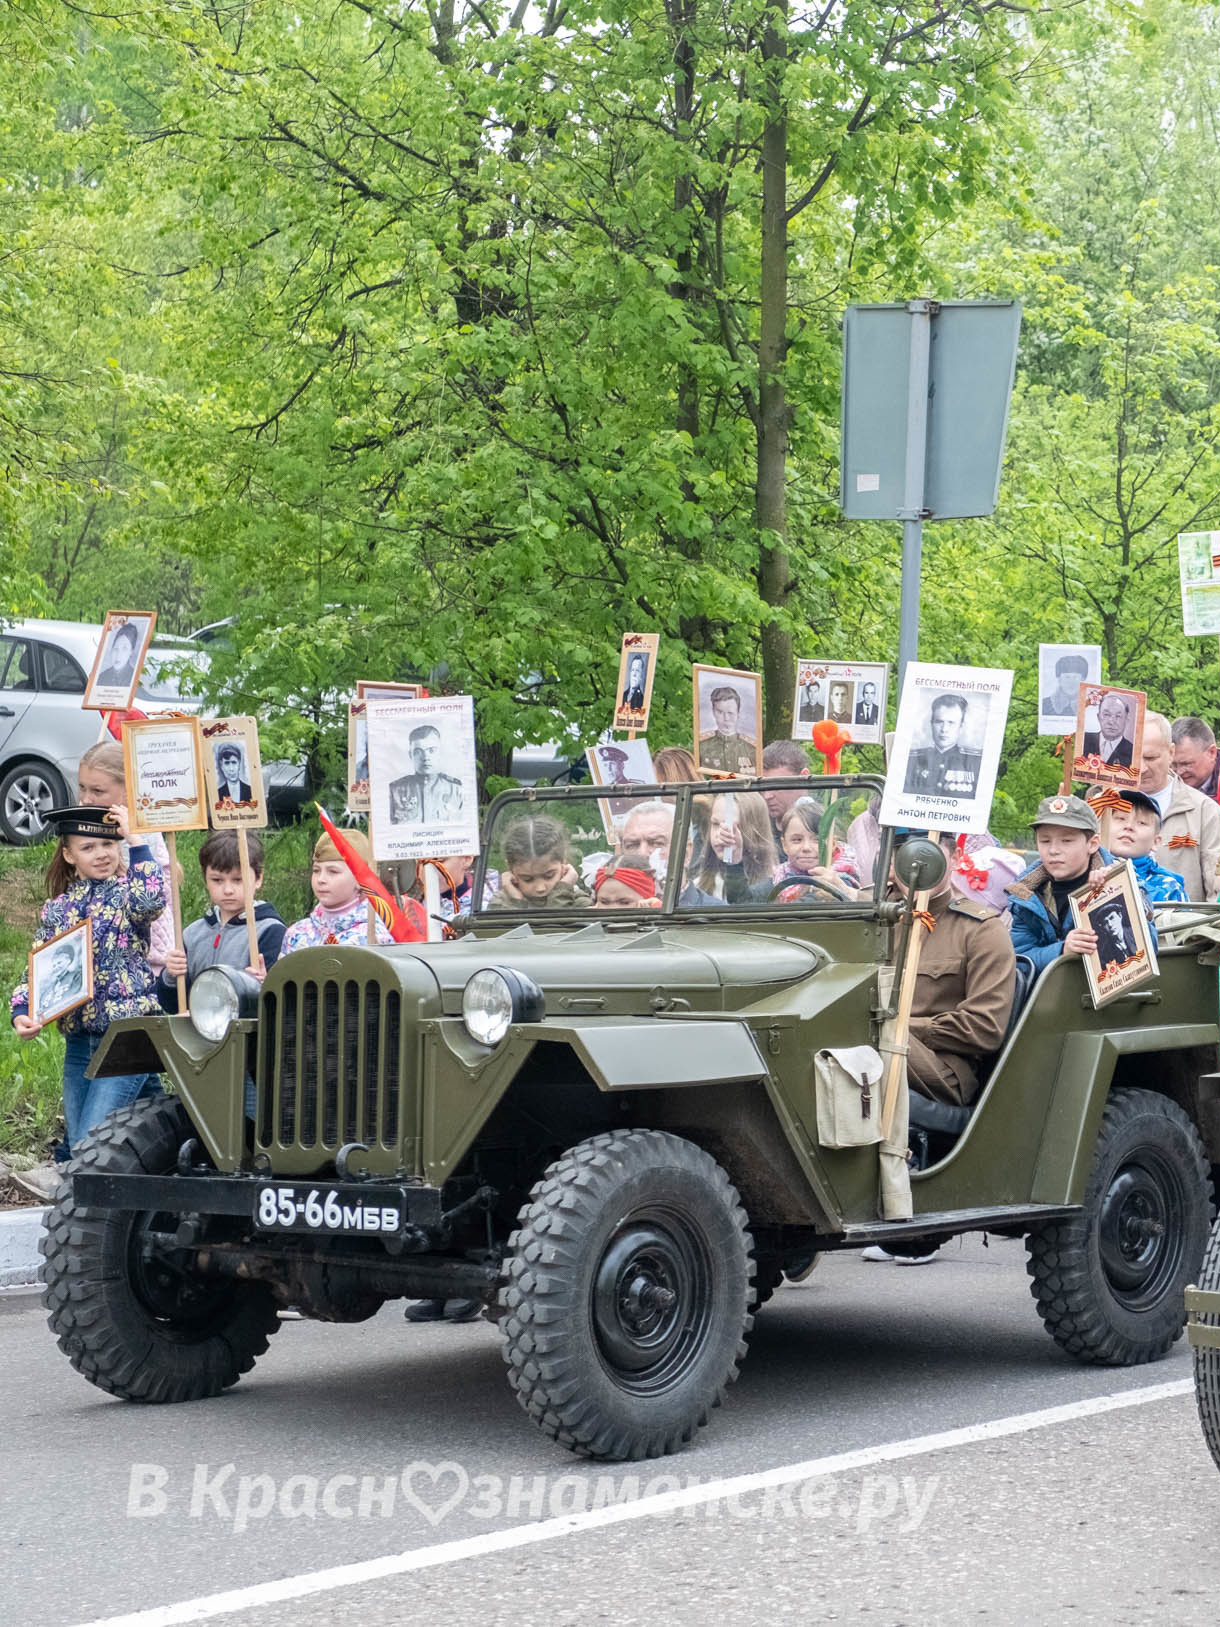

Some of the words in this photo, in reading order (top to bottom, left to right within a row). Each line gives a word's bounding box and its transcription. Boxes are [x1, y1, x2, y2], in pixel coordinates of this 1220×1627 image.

[915, 677, 975, 691] БЕССМЕРТНЫЙ
[976, 682, 1001, 692] ПОЛК
[375, 703, 437, 716] БЕССМЕРТНЫЙ
[439, 703, 464, 712] ПОЛК
[151, 779, 178, 789] ПОЛК
[914, 795, 959, 808] РЯБЧЕНКО
[897, 808, 926, 819] АНТОН
[927, 811, 971, 823] ПЕТРОВИЧ
[388, 841, 424, 849] ВЛАДИМИР
[427, 838, 470, 847] АЛЕКСЕЕВИЧ
